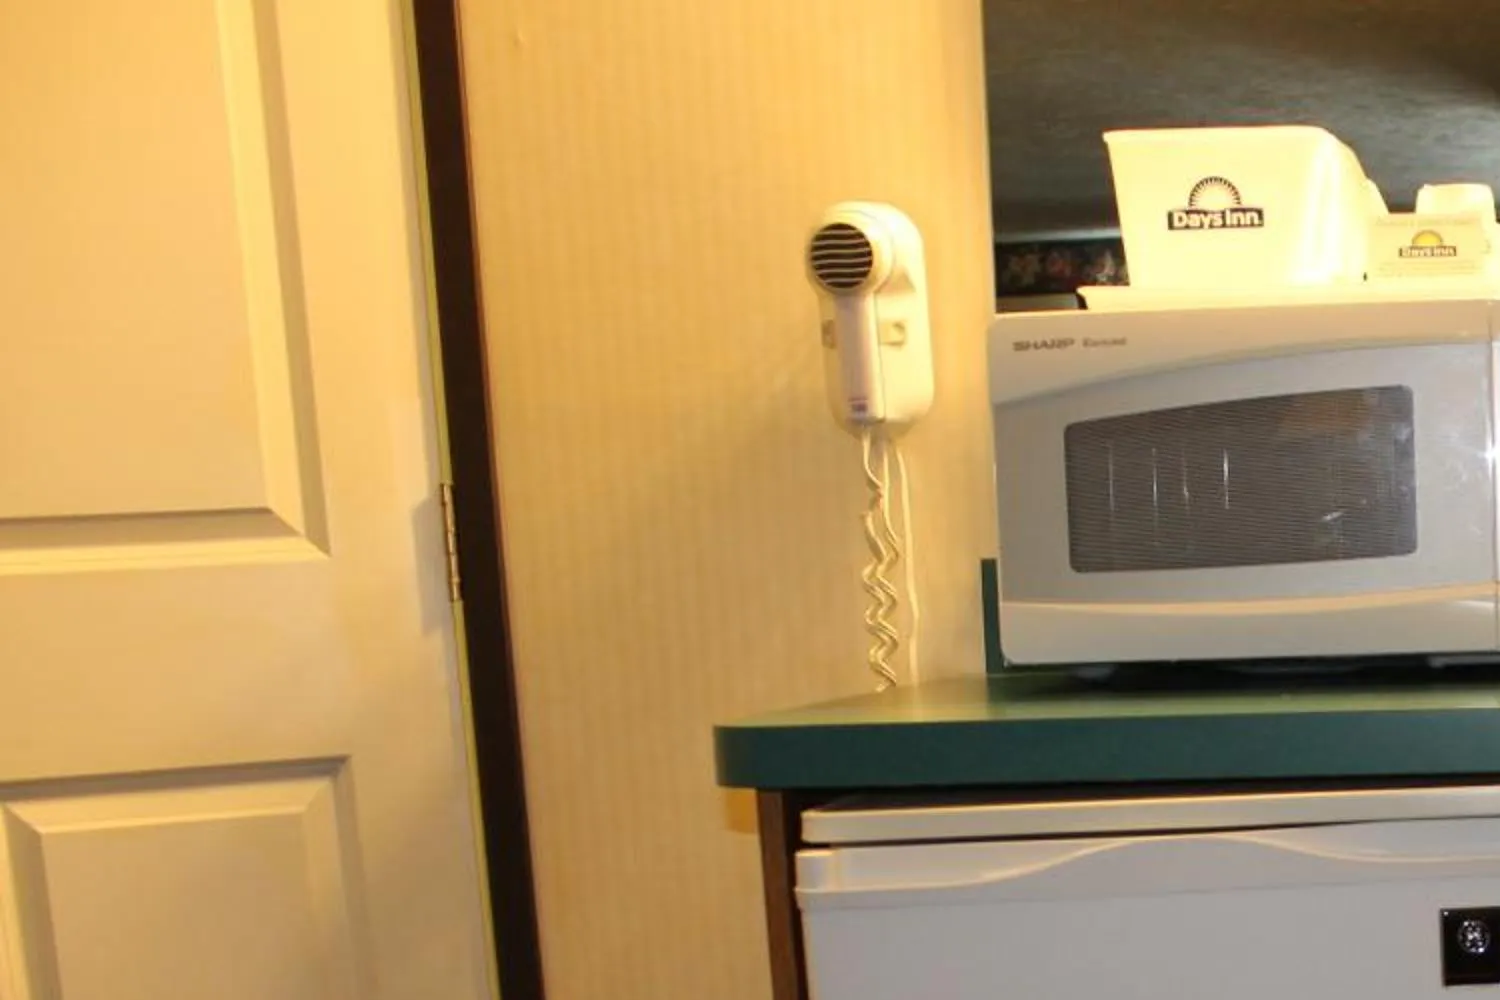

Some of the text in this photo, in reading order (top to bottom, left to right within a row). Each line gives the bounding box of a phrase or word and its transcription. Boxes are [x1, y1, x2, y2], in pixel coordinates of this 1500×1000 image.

[1172, 209, 1258, 229] Days Inn
[1013, 338, 1076, 351] SHARP
